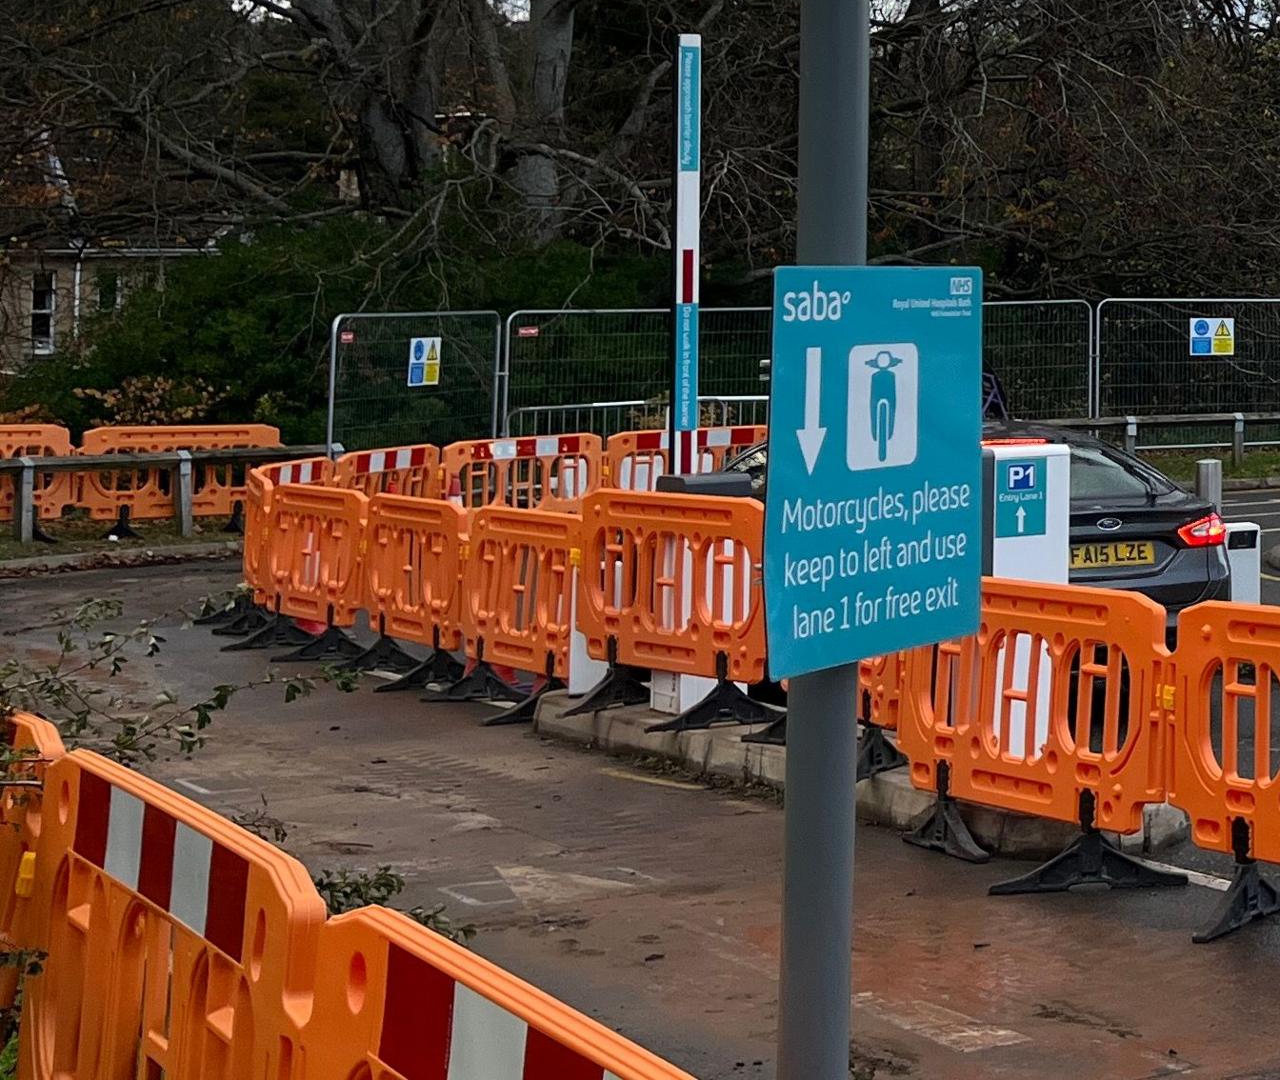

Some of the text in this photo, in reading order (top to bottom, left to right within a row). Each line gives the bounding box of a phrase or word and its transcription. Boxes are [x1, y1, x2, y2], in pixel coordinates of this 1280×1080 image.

[685, 52, 693, 77] Please
[682, 78, 692, 114] approach
[684, 114, 692, 140] barrier
[952, 279, 970, 293] NHS
[683, 306, 691, 317] Do
[683, 351, 690, 359] in
[682, 379, 690, 387] of
[1009, 466, 1034, 488] P1
[781, 480, 970, 534] Motorcycles, please
[999, 491, 1042, 503] Entry Lane 1
[784, 529, 966, 592] keep to left and use
[1071, 543, 1148, 565] FA15 LZE
[794, 576, 958, 639] lane 1 for free exit
